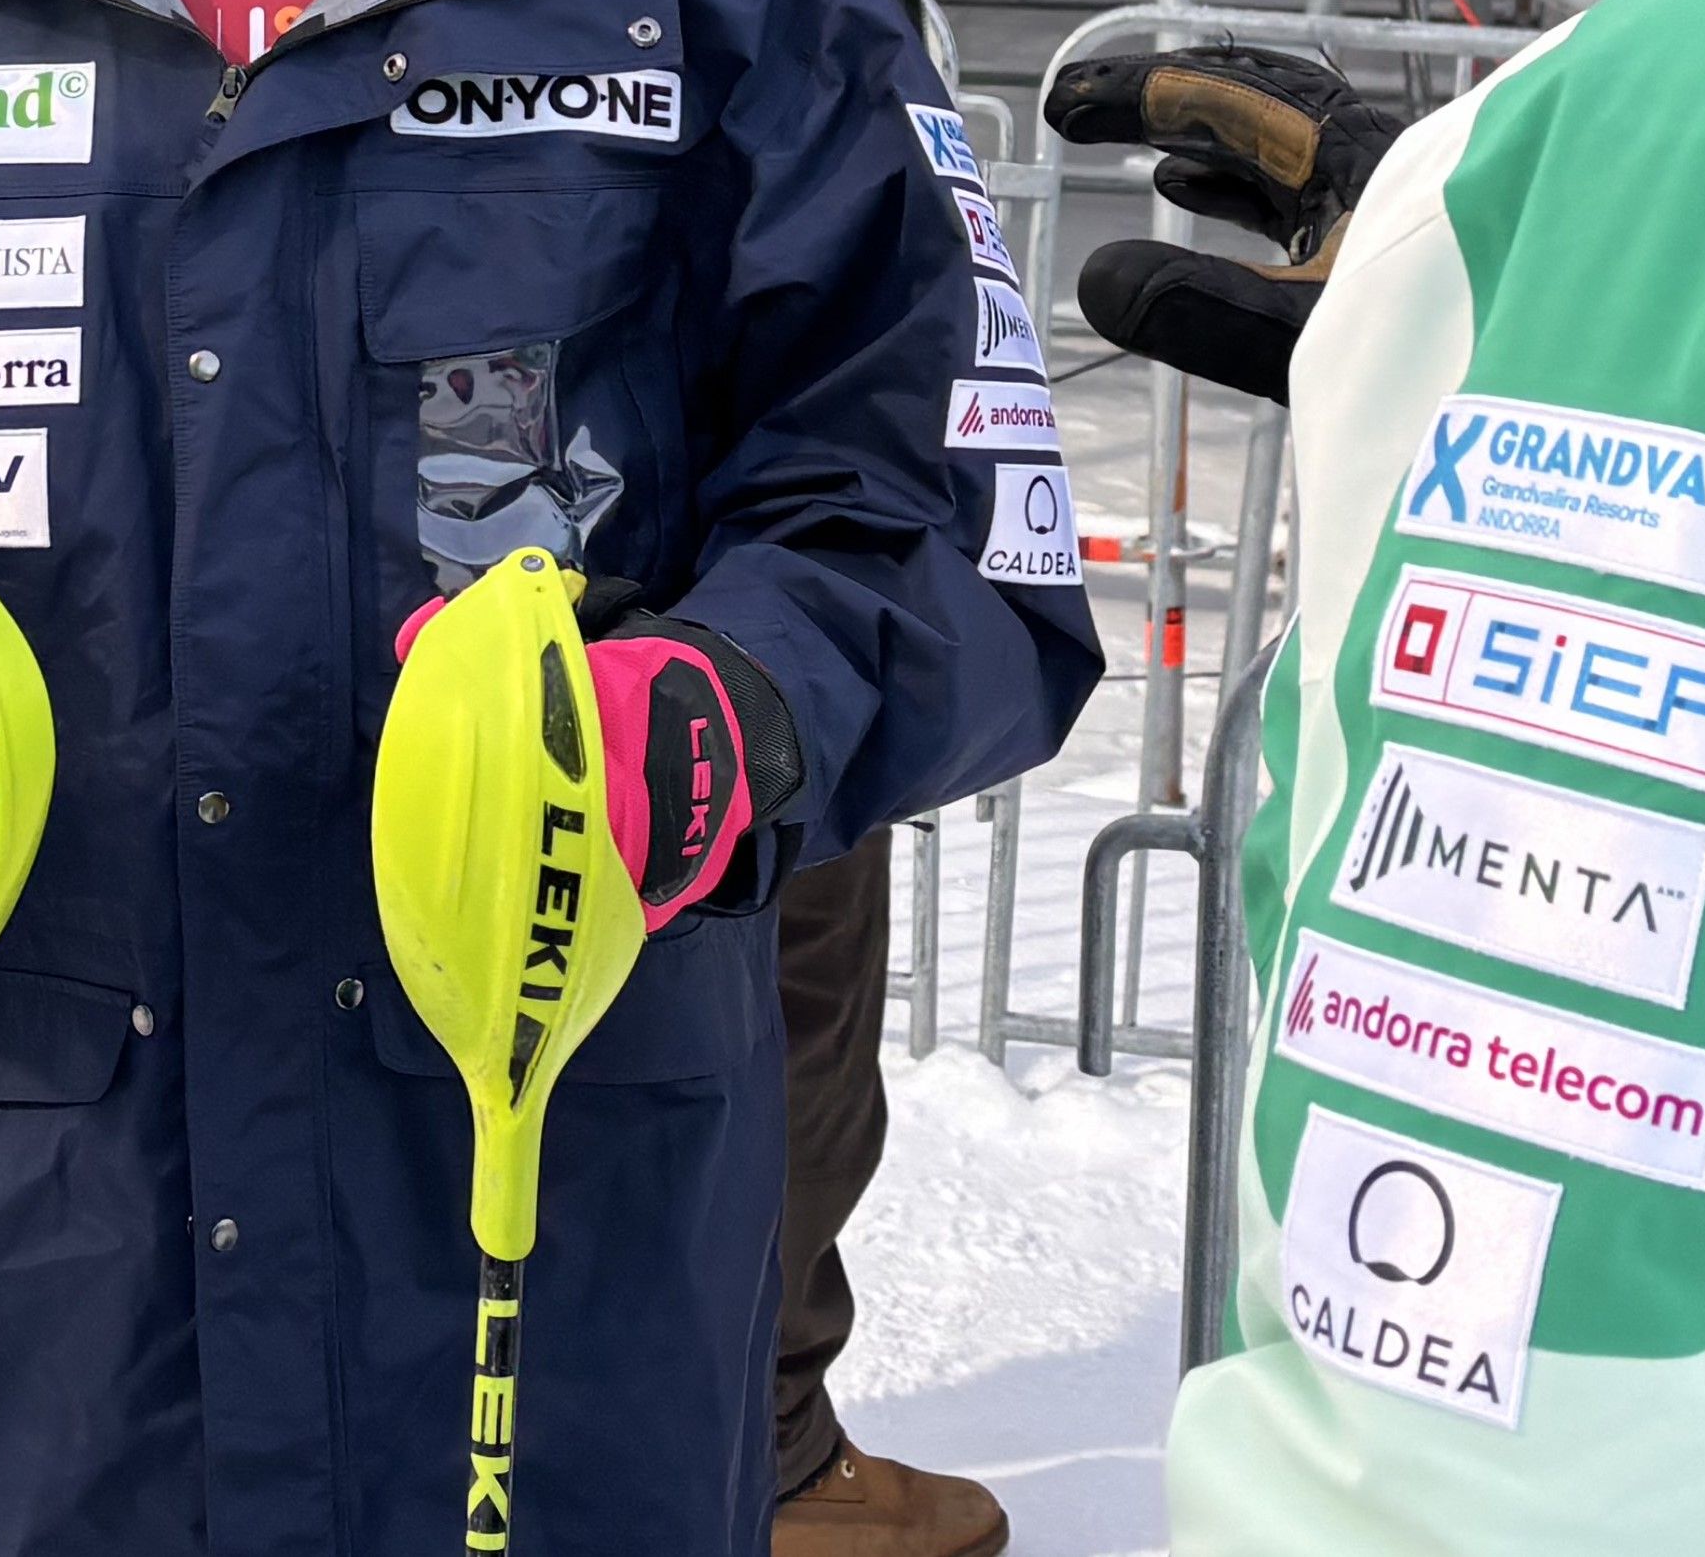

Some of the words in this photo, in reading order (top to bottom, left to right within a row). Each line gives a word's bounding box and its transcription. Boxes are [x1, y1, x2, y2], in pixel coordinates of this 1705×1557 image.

[406, 74, 674, 128] ONYONE
[990, 402, 1043, 428] andorra
[1477, 506, 1561, 539] ANDORRA
[1482, 475, 1582, 513] Grandvalira
[1583, 494, 1661, 529] Resorts
[987, 549, 1077, 576] CALDEA
[680, 716, 714, 859] LEKI
[518, 800, 586, 1002] LEKI
[1426, 831, 1658, 935] MENTA
[1322, 989, 1473, 1069] andorra
[1487, 1035, 1705, 1137] telecom
[1290, 1284, 1502, 1405] CALDEA
[465, 1298, 519, 1551] LEKI
